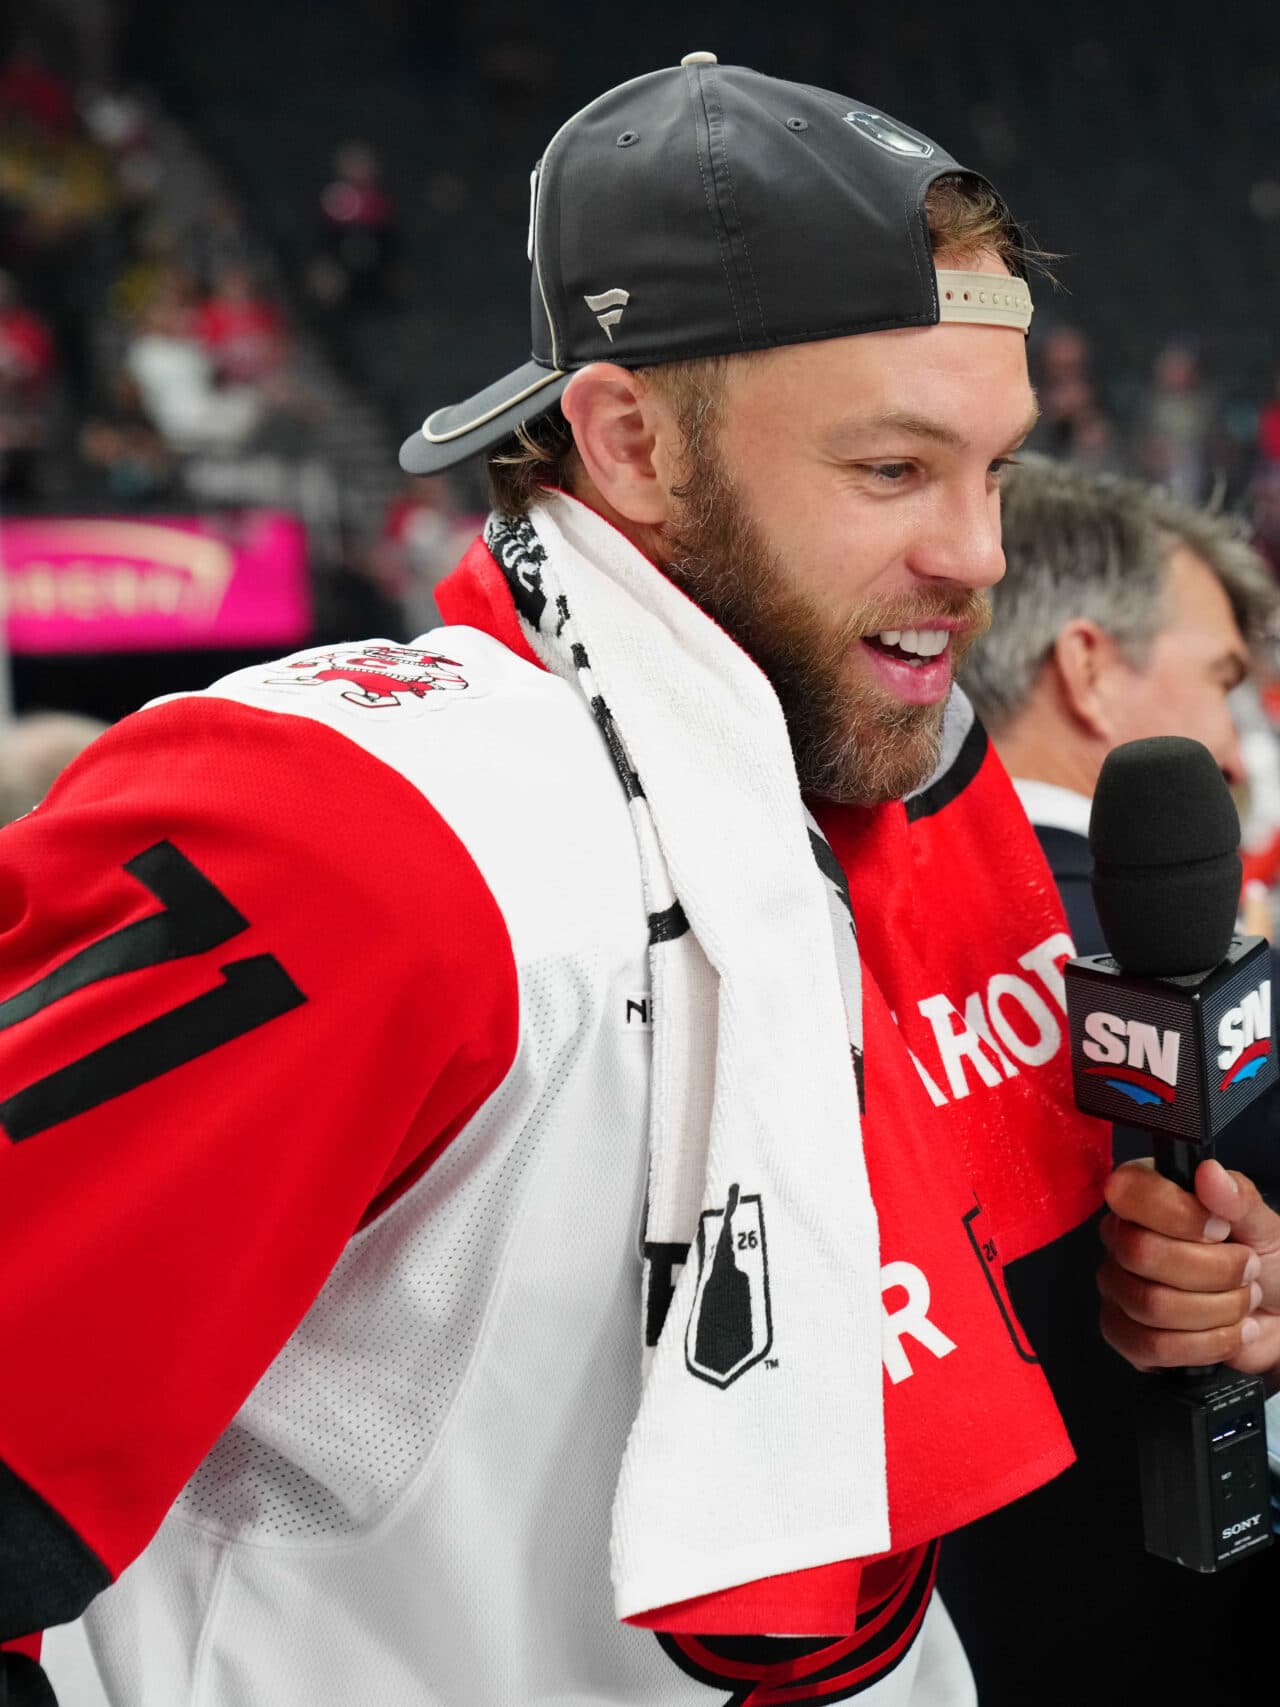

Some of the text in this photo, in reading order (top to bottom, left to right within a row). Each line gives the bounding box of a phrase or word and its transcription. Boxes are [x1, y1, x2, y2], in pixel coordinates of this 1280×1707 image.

[0, 839, 308, 1143] 71
[1082, 1011, 1181, 1087] SN
[1218, 980, 1272, 1071] SN
[737, 1230, 759, 1250] 26
[764, 1358, 779, 1371] TM
[1222, 1513, 1262, 1539] SONY
